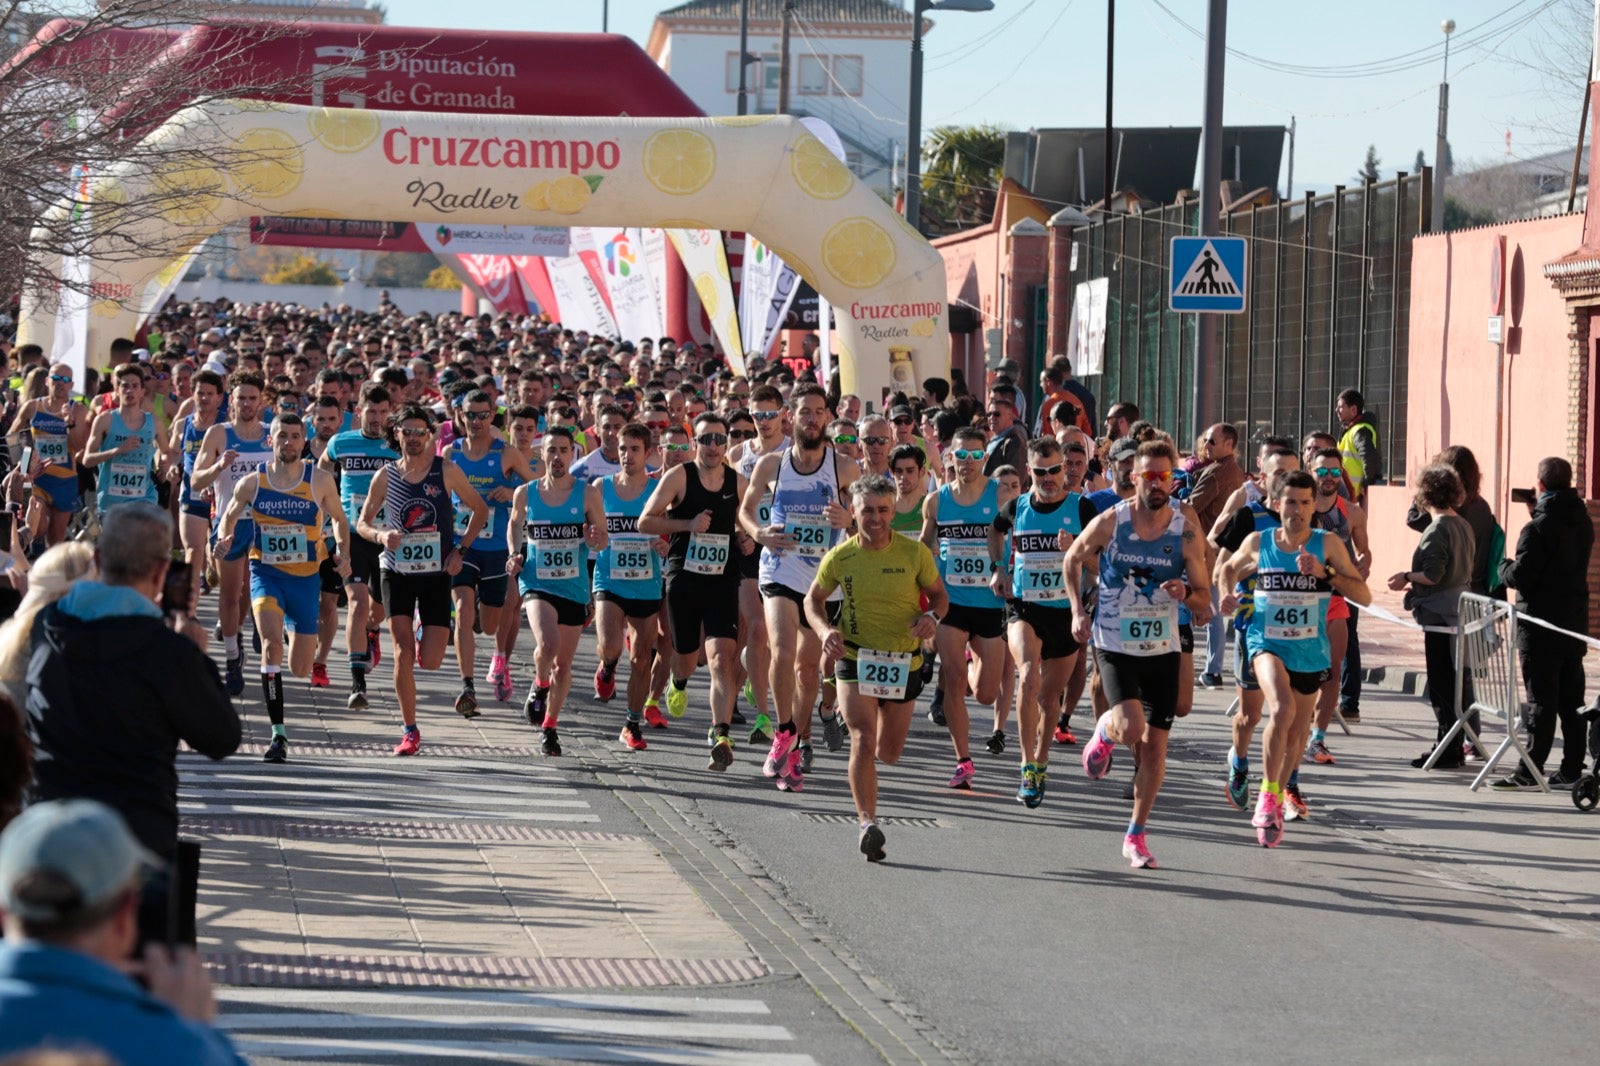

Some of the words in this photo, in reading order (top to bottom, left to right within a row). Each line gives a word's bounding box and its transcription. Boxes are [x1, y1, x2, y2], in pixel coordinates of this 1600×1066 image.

[380, 49, 515, 78] Diputación
[377, 81, 405, 104] de
[411, 83, 516, 109] Granada
[383, 126, 620, 175] Cruzcampo
[406, 178, 522, 213] Radler
[346, 221, 396, 237] GRANAA
[453, 230, 525, 241] MERCAGRANADA
[851, 302, 942, 319] Cruzcampo
[860, 325, 909, 342] Radler
[40, 443, 63, 457] 499
[112, 473, 144, 487] 1047
[258, 498, 311, 511] agustinos
[783, 504, 807, 512] TODO
[792, 526, 824, 544] 526
[268, 537, 298, 552] 501
[402, 545, 434, 560] 920
[543, 551, 573, 567] 366
[617, 552, 648, 567] 855
[690, 544, 727, 562] 1030
[1117, 553, 1144, 563] TODO
[1146, 556, 1172, 567] SUMA
[953, 558, 985, 573] 369
[1029, 572, 1061, 587] 767
[1273, 608, 1309, 625] 461
[1129, 620, 1163, 638] 679
[865, 664, 900, 684] 283
